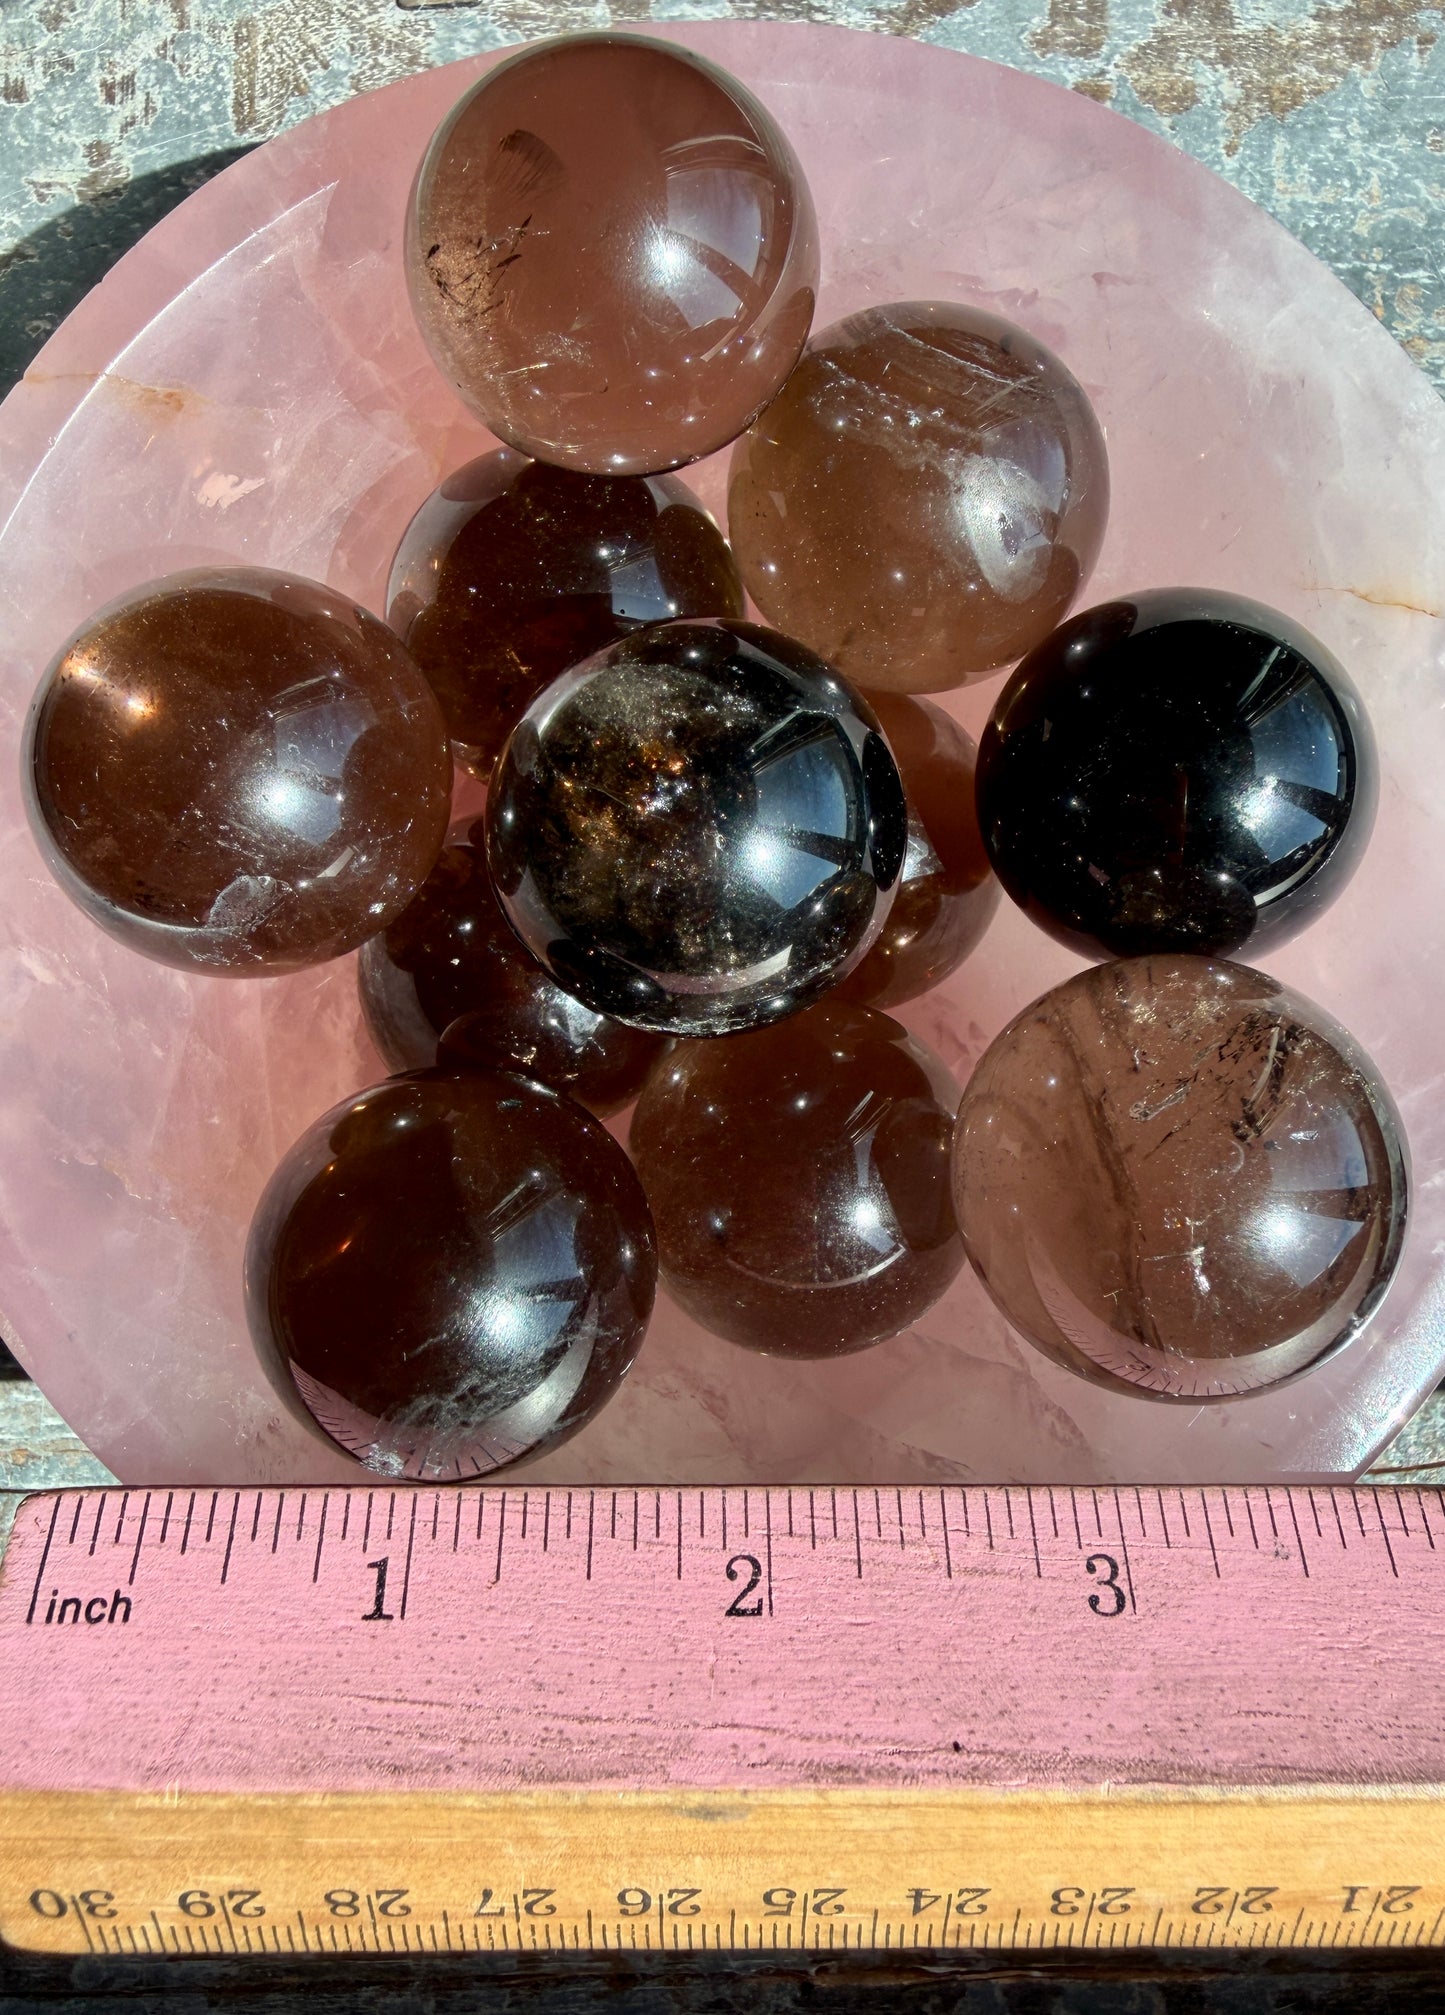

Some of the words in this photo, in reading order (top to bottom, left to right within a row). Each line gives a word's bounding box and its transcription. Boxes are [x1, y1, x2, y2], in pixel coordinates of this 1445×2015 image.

[45, 1589, 132, 1624] inch
[361, 1557, 394, 1621] 1
[724, 1554, 763, 1617] 2
[1086, 1553, 1127, 1617] 3
[29, 1888, 119, 1920] 30
[178, 1888, 266, 1919] 29
[323, 1888, 412, 1919] 28
[473, 1887, 558, 1918] 27
[617, 1887, 704, 1918] 26
[762, 1887, 847, 1917] 25
[906, 1887, 989, 1917] 24
[1050, 1887, 1137, 1916] 23
[1190, 1885, 1281, 1916] 22
[1341, 1885, 1423, 1915] 21
